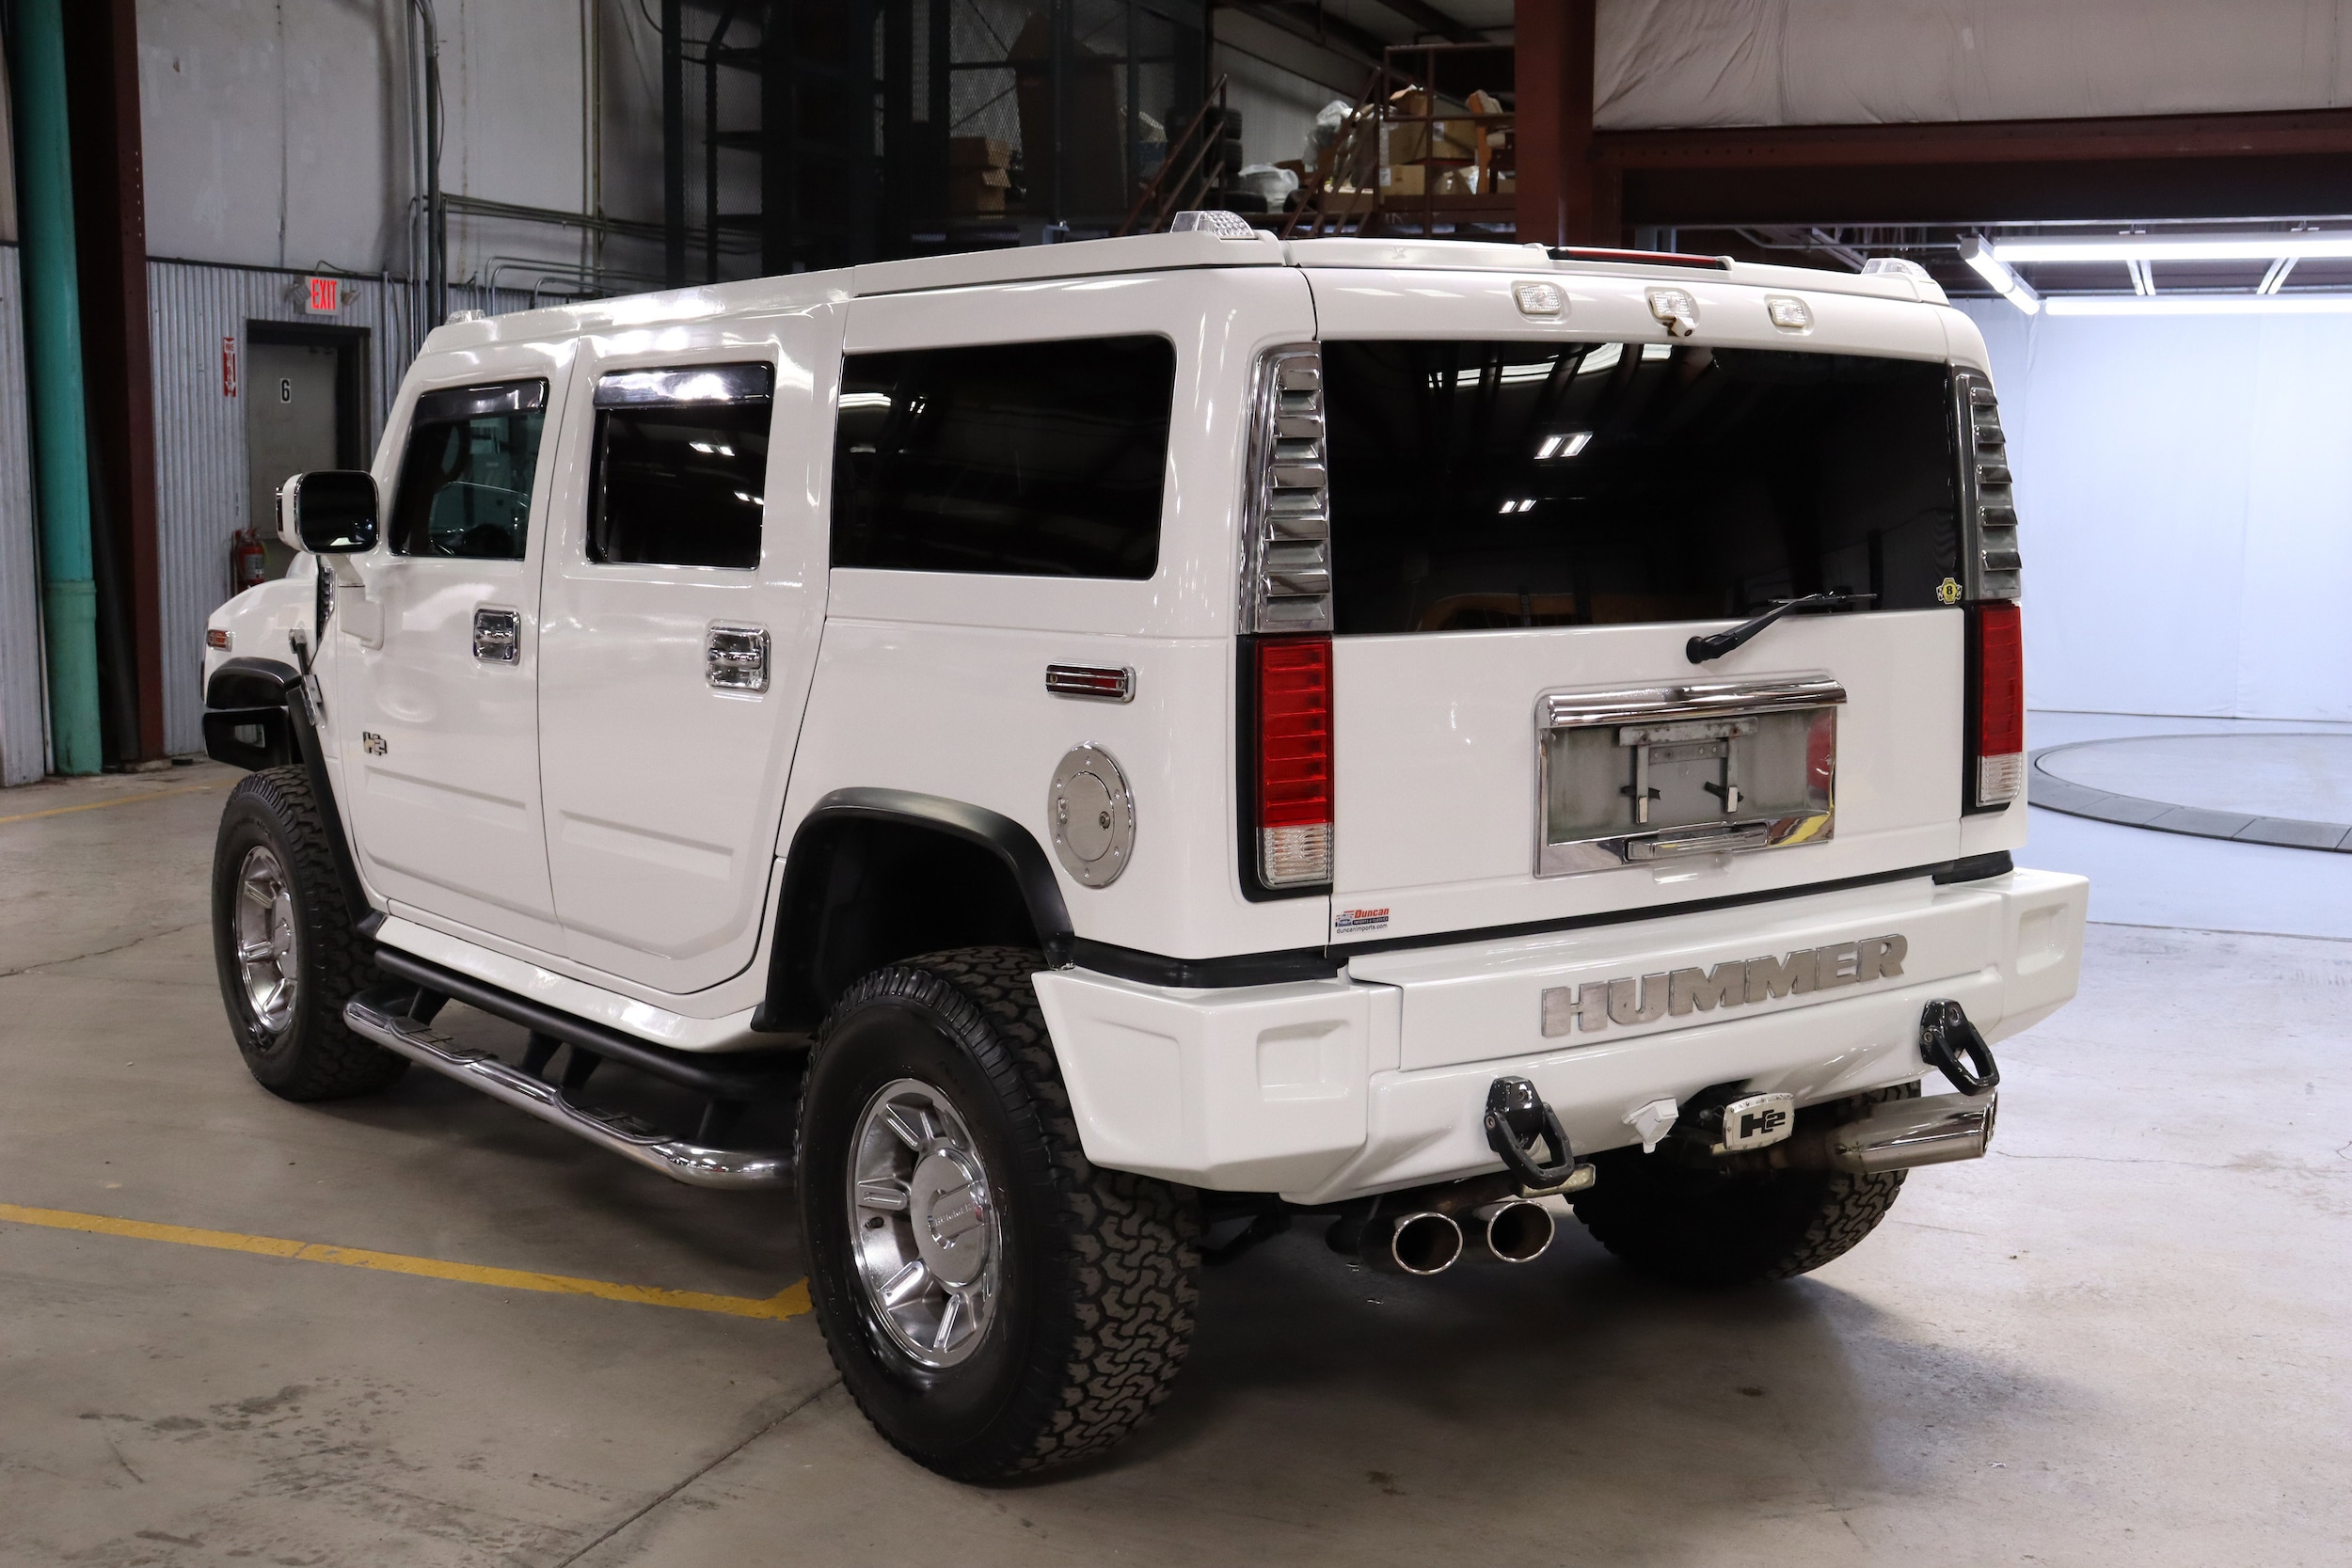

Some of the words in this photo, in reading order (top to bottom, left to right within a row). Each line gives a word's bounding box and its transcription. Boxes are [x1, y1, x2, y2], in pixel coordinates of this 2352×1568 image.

[311, 278, 337, 310] EXIT
[281, 379, 290, 402] 6
[1947, 586, 1953, 594] 8
[1355, 909, 1390, 918] Duncan
[1337, 924, 1388, 933] duncanimports.com
[1541, 934, 1908, 1037] HUMMER
[1740, 1109, 1786, 1138] H2
